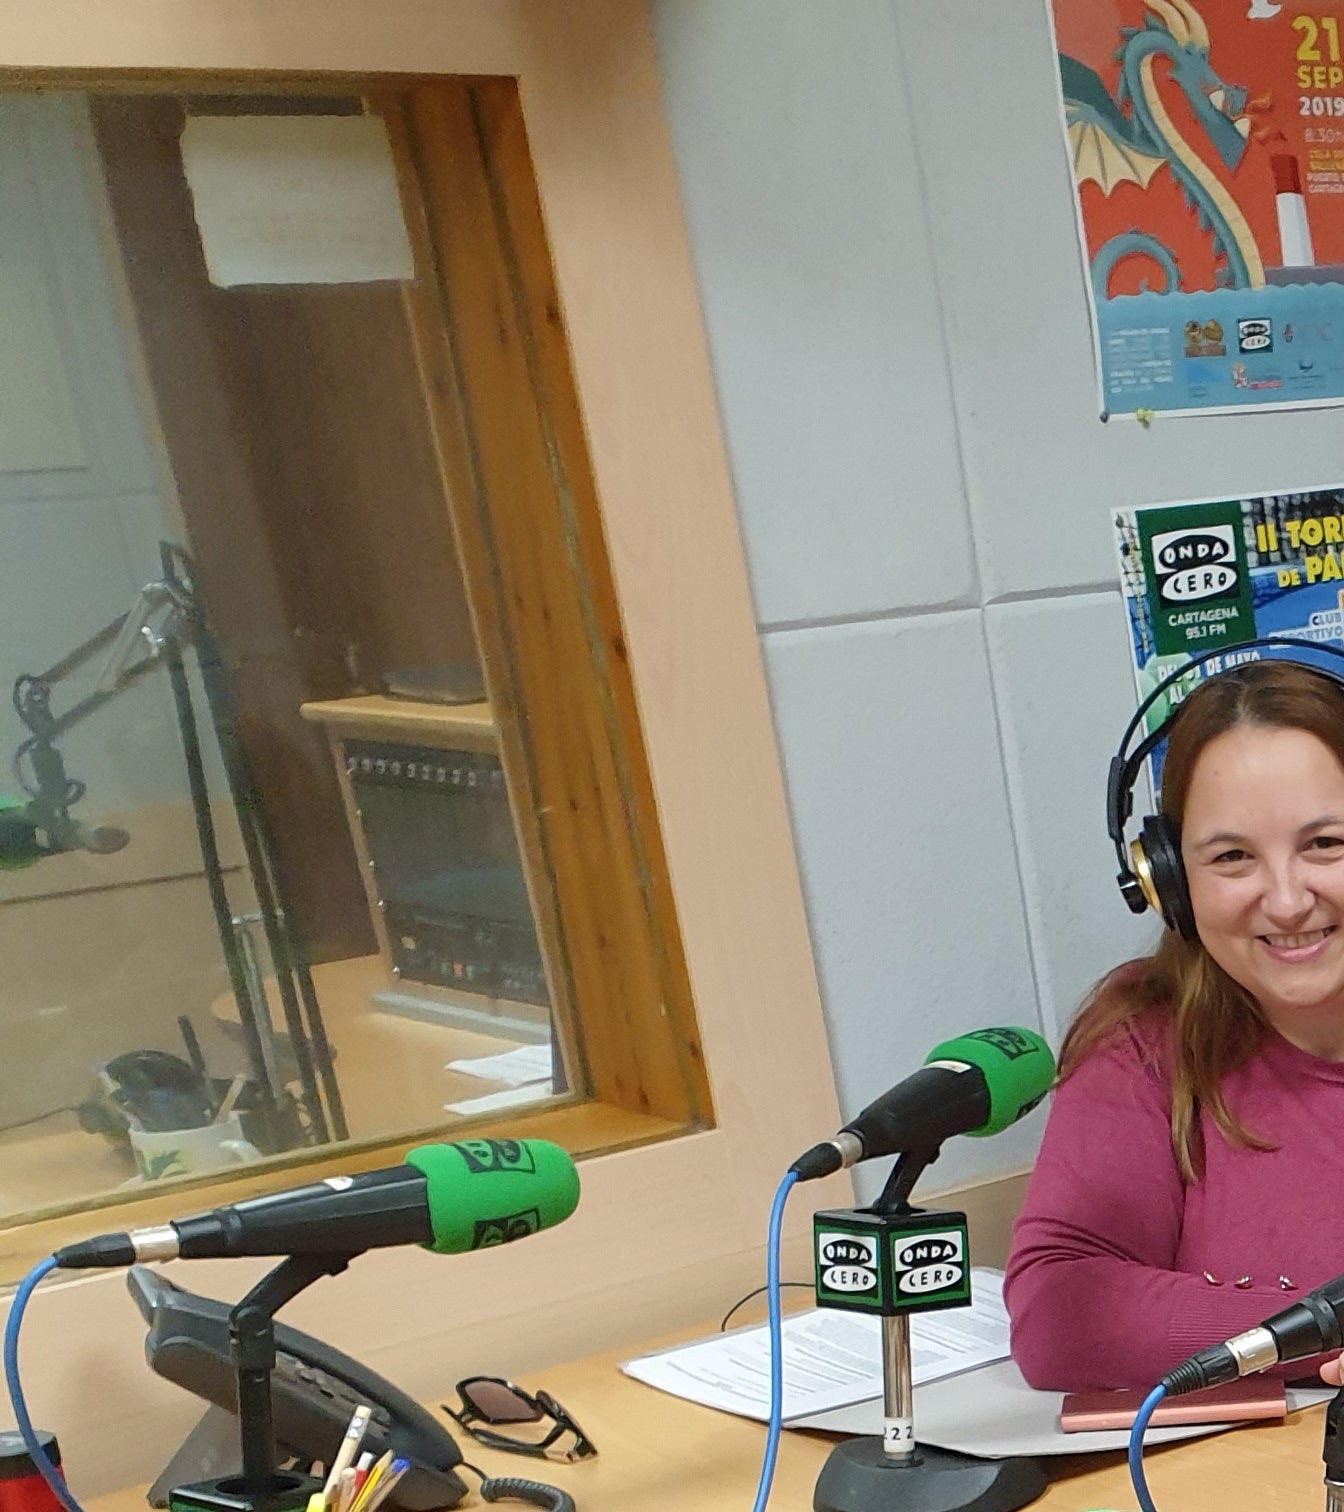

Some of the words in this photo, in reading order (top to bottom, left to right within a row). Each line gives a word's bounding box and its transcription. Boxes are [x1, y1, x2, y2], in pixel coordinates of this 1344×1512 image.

[1291, 15, 1340, 62] 21
[1297, 65, 1344, 89] SEP
[1256, 523, 1277, 553] II
[1163, 541, 1225, 564] ONDA
[1173, 572, 1227, 594] CERO
[1277, 570, 1301, 588] DE
[1168, 606, 1239, 627] CARTAGENA
[1312, 611, 1343, 626] CLUB
[1208, 623, 1227, 635] FM
[826, 1245, 869, 1261] ONDA
[903, 1244, 953, 1263] ONDA
[831, 1270, 869, 1286] CERO
[909, 1269, 954, 1287] CERO
